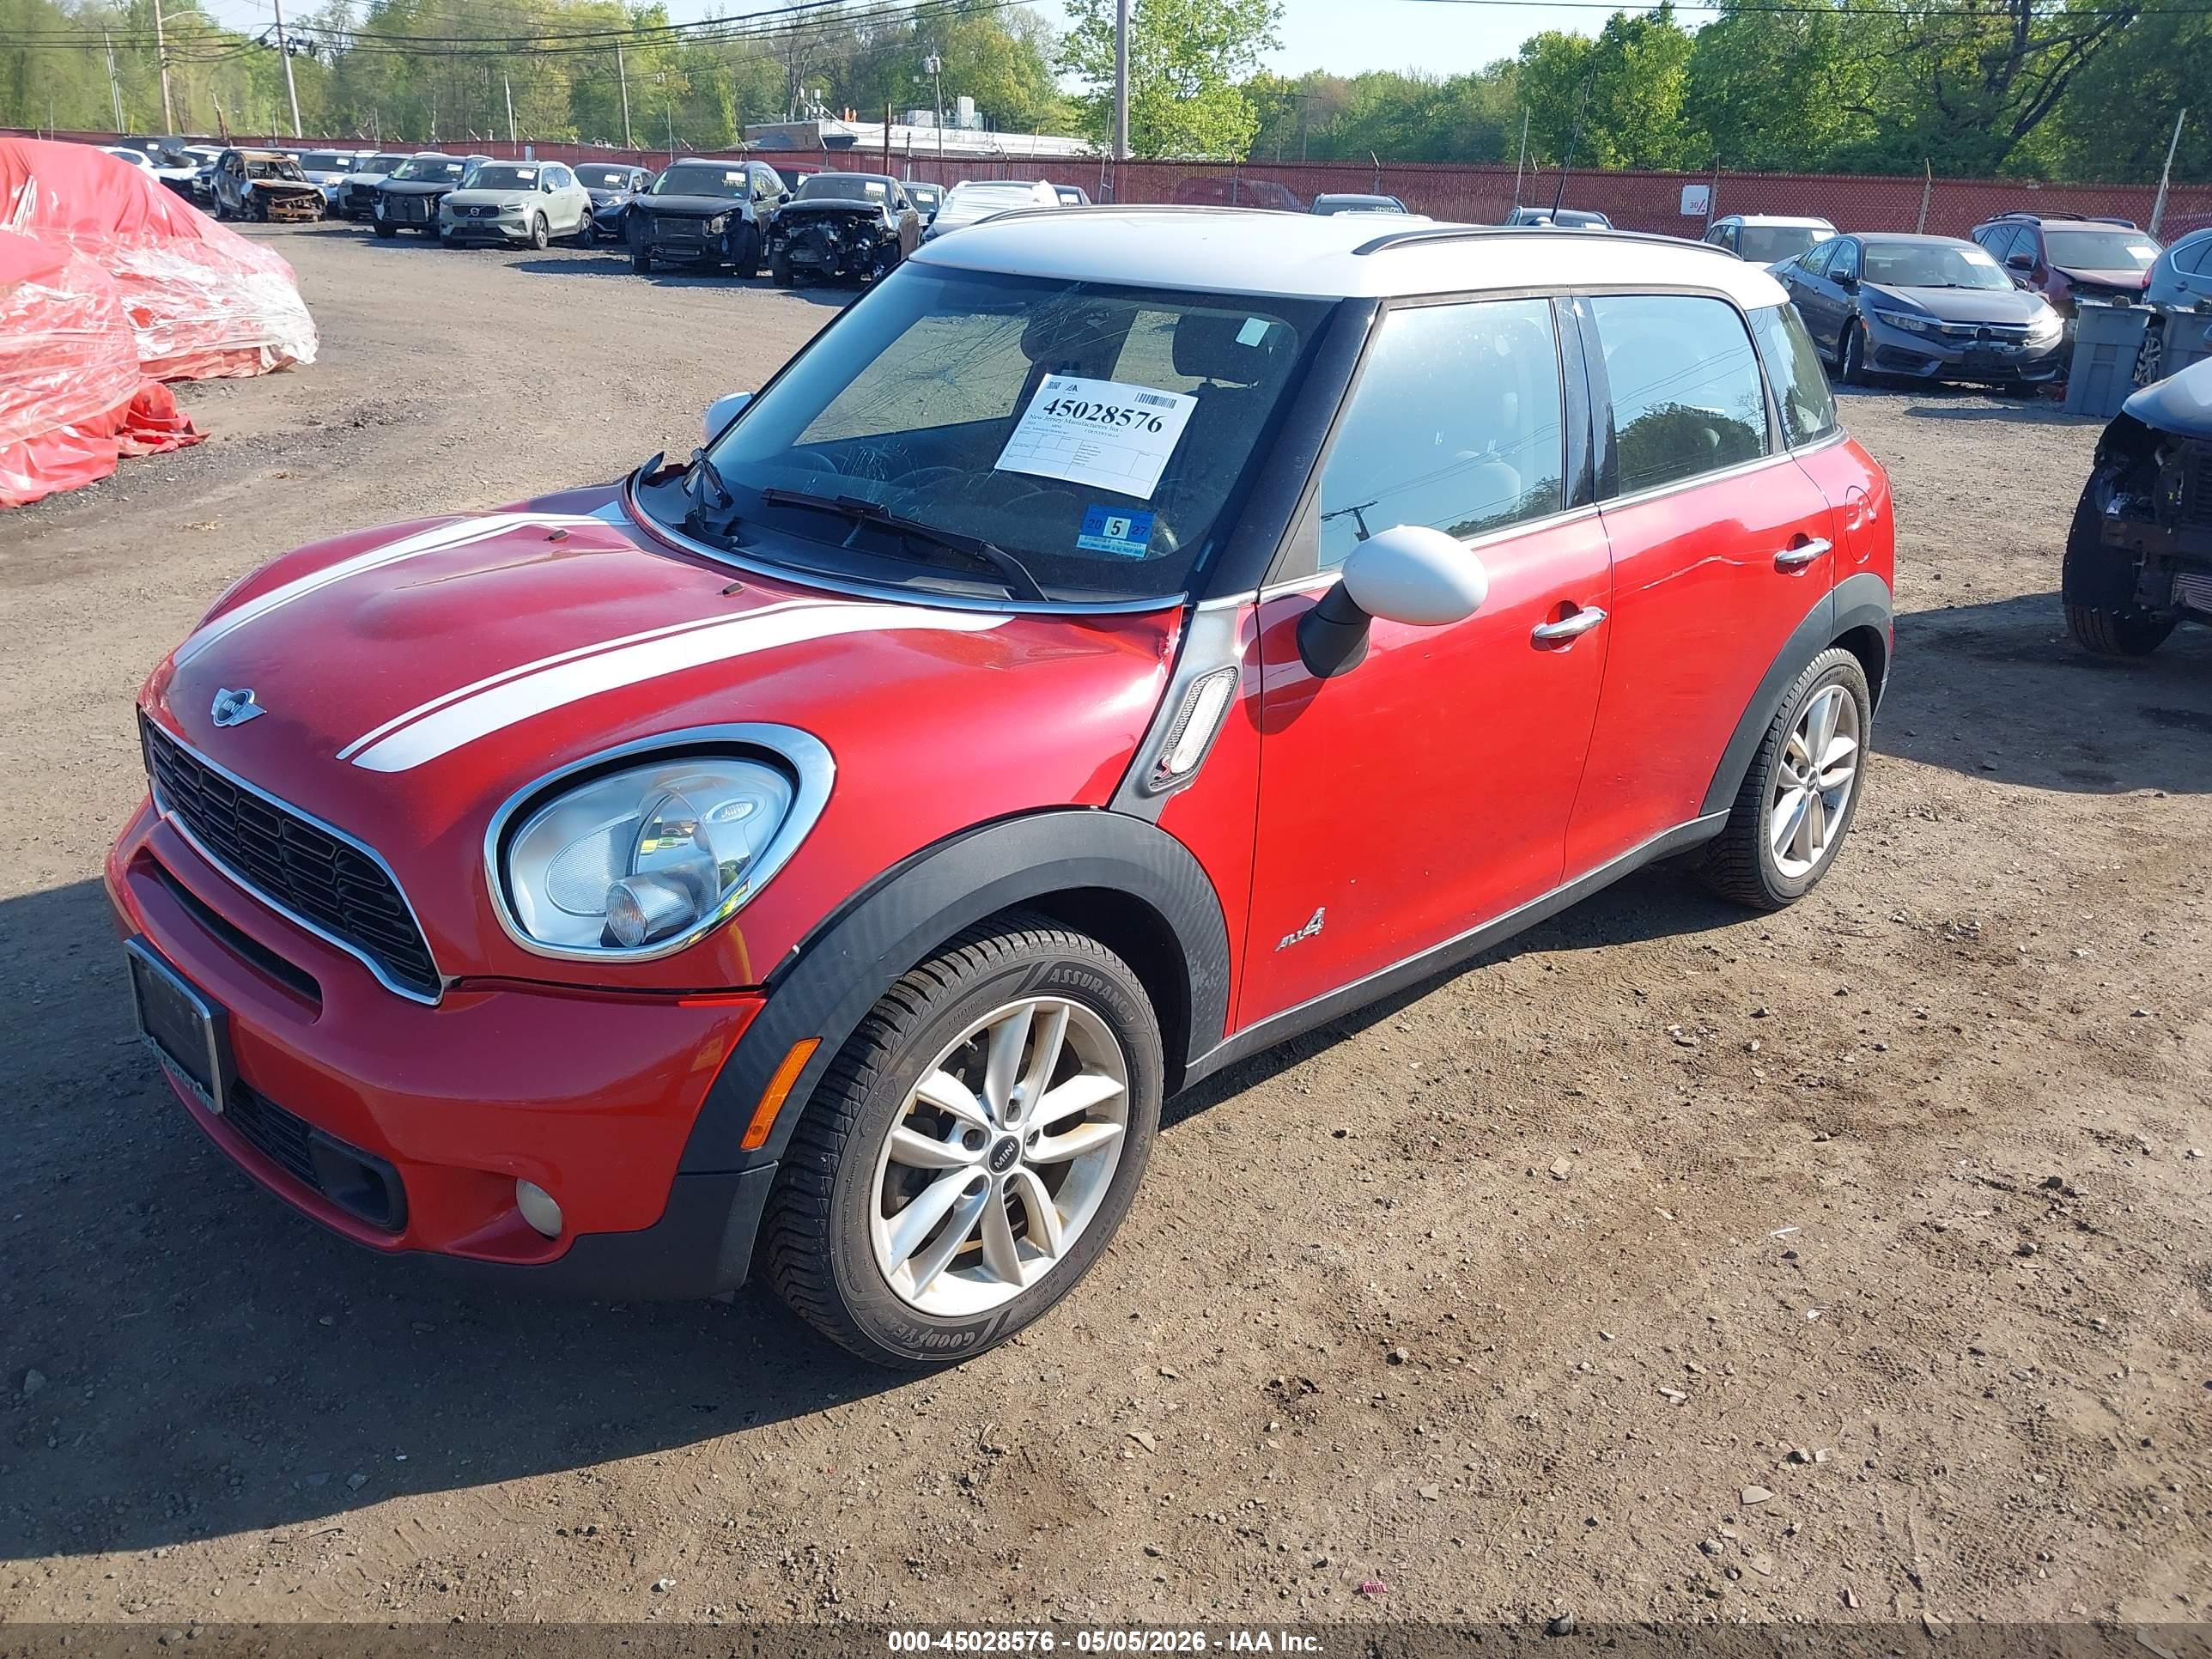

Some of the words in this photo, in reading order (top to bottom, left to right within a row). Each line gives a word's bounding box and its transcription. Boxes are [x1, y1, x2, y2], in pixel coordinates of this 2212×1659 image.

[1042, 398, 1167, 434] 45028576
[1043, 415, 1065, 424] Jersey
[1063, 417, 1108, 430] Manufacturers
[1088, 519, 1103, 530] 20
[1110, 520, 1123, 536] 5
[1131, 525, 1149, 537] 27
[1047, 968, 1135, 1024] ASSURANCE
[994, 1140, 1016, 1169] MINI
